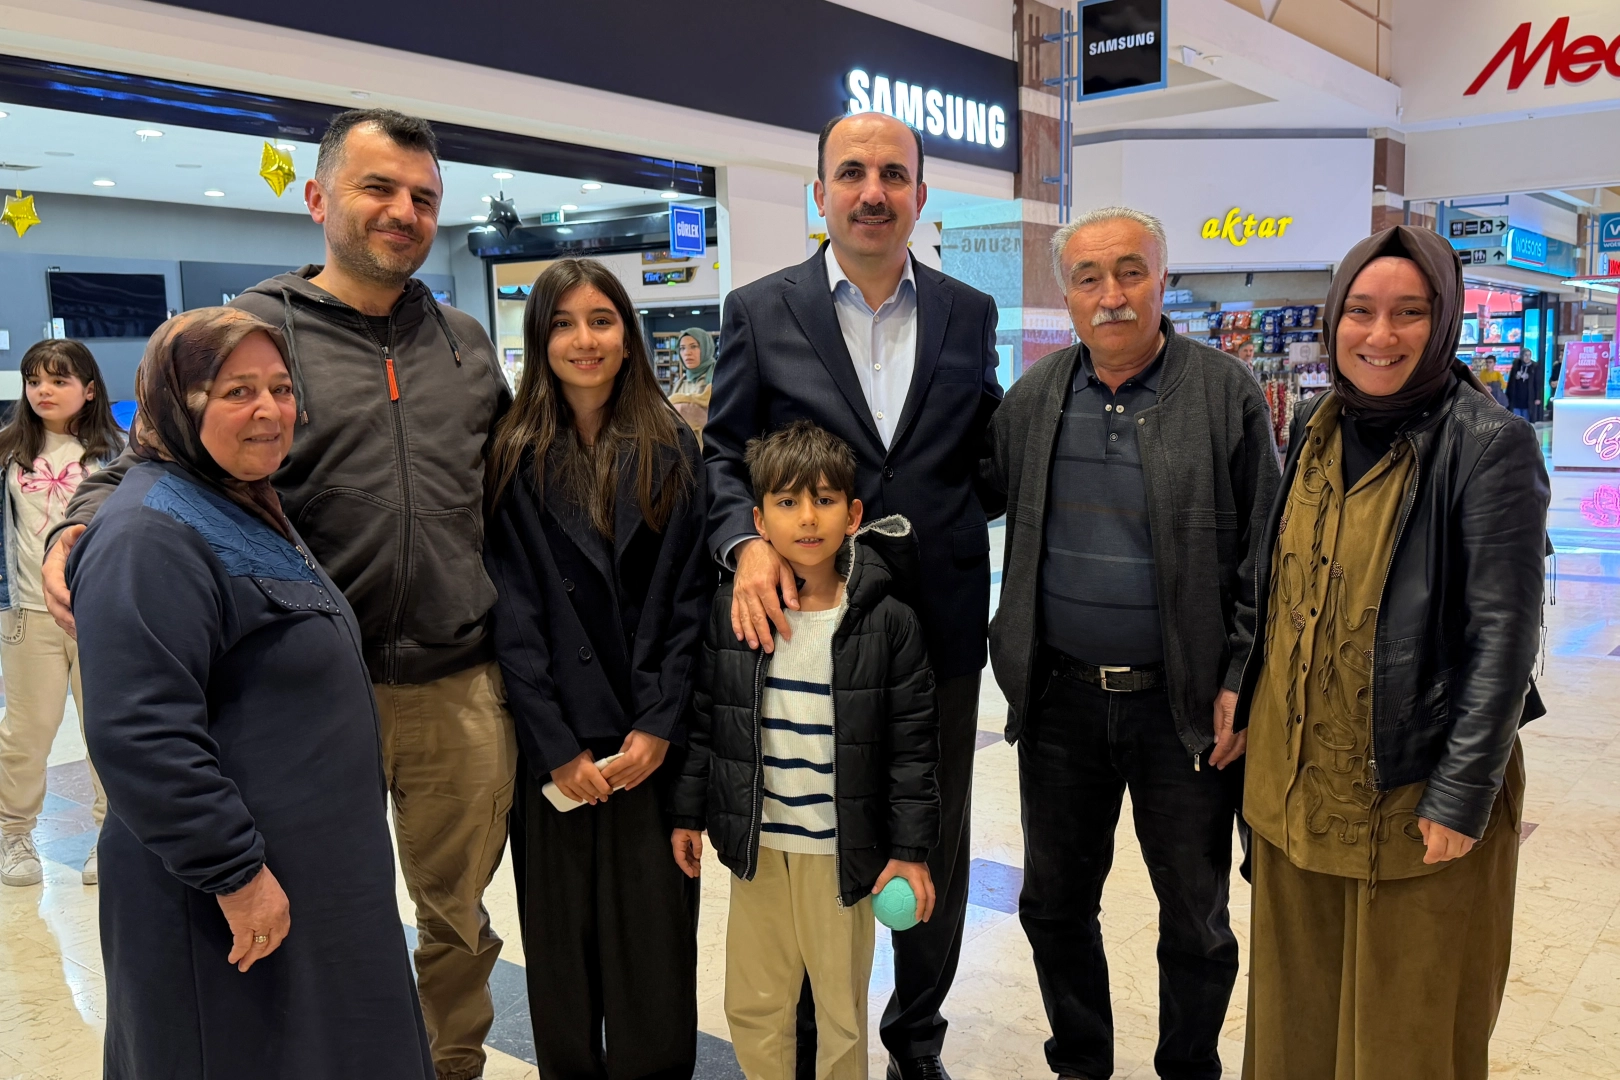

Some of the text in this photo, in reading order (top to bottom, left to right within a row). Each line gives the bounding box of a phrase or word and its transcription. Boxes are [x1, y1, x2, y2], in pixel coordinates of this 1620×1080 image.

[1088, 31, 1155, 56] SAMSUNG
[848, 69, 1006, 149] SAMSUNG
[676, 221, 699, 238] GÜRLEK
[1201, 207, 1293, 247] aktar
[1515, 236, 1542, 257] watsons
